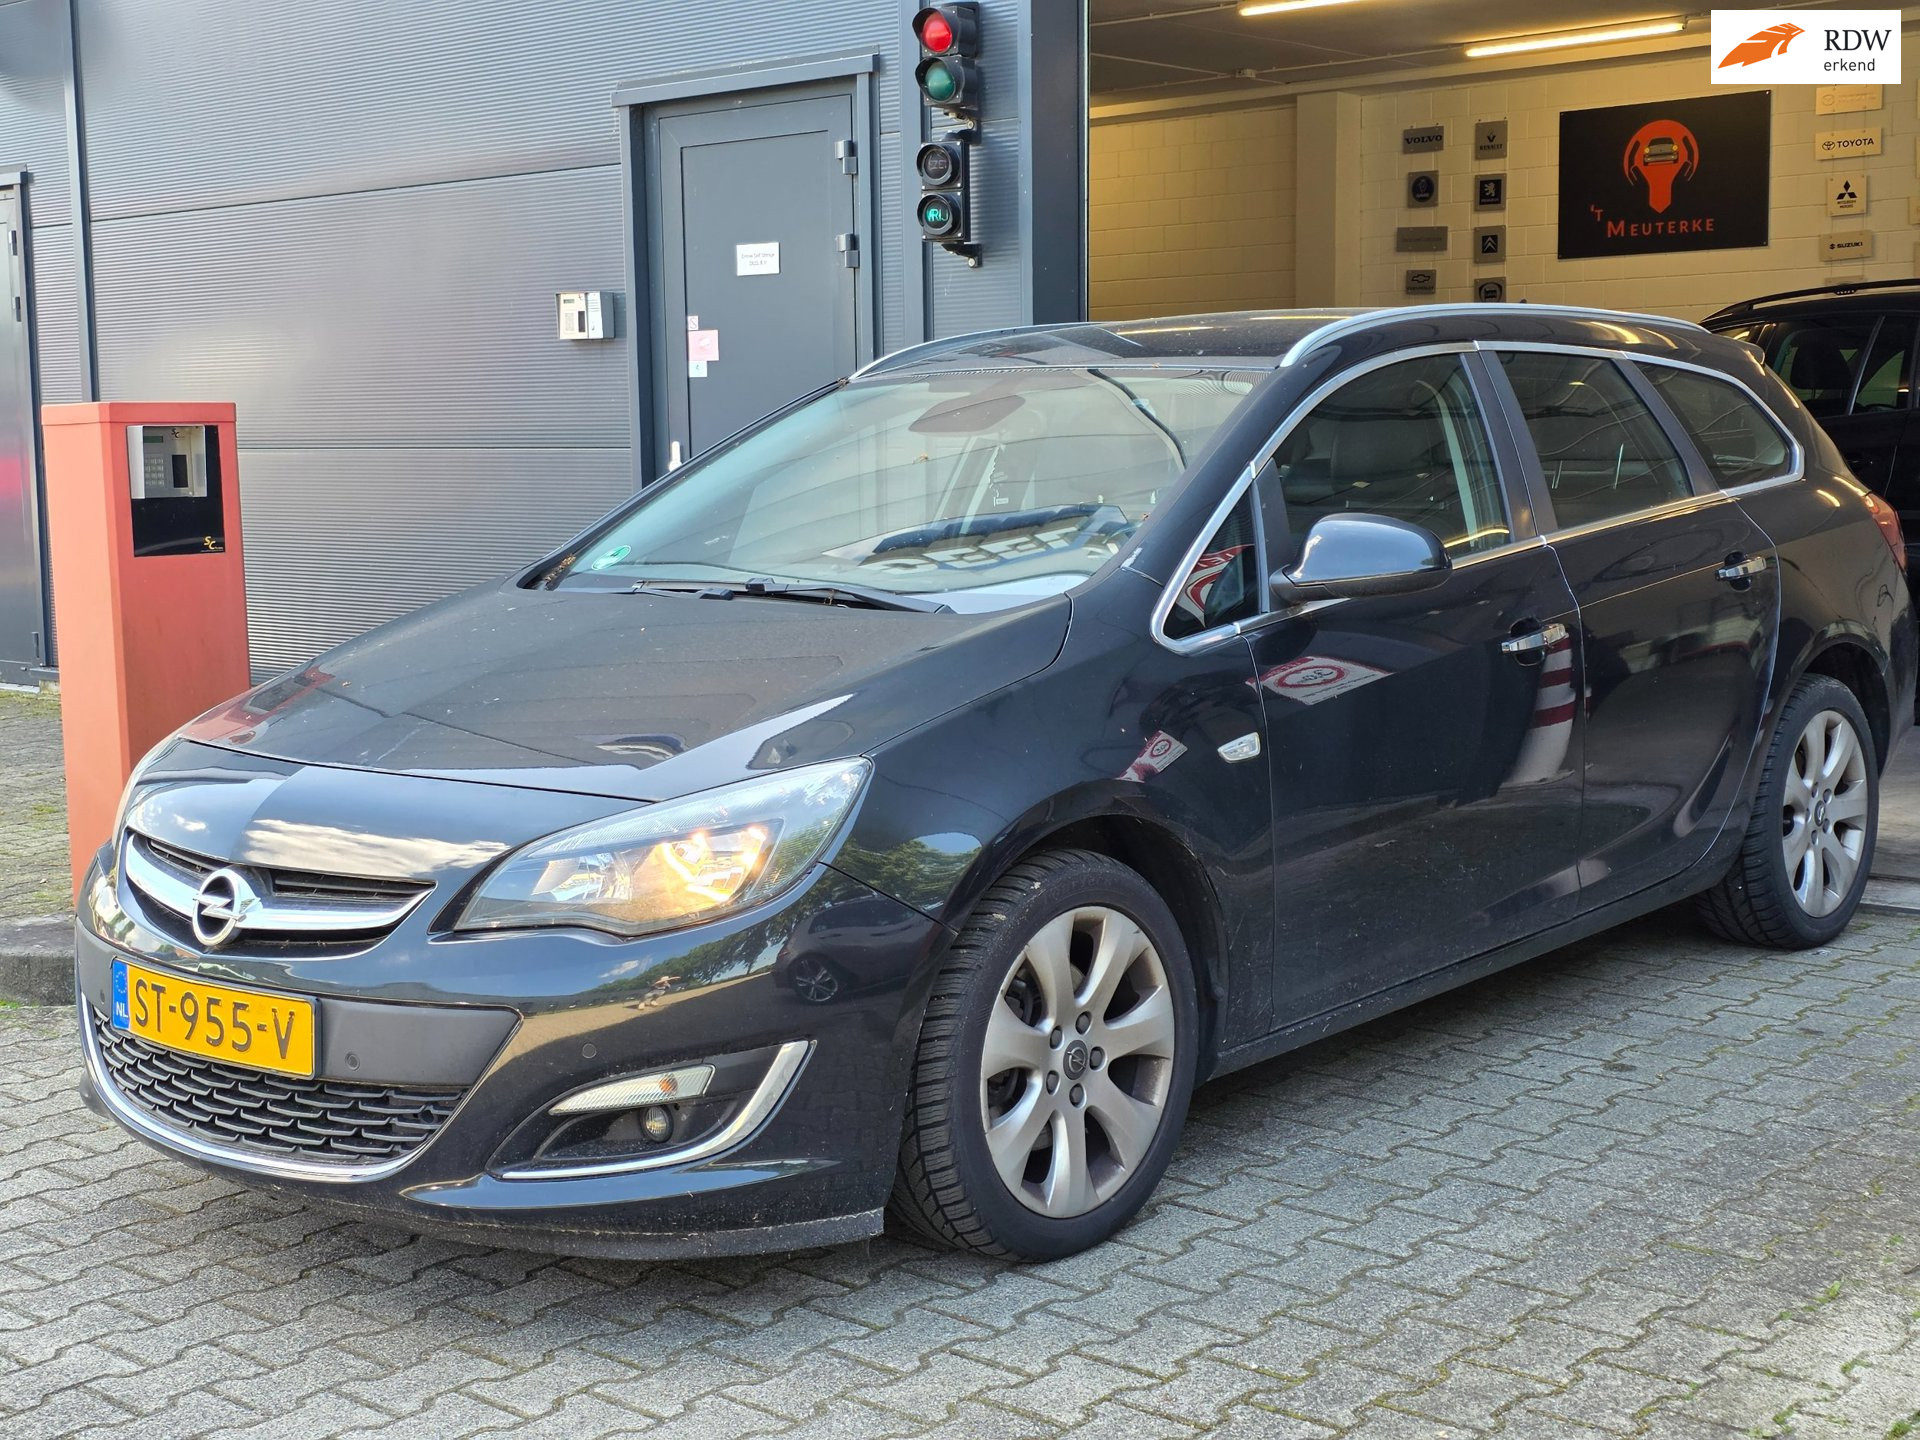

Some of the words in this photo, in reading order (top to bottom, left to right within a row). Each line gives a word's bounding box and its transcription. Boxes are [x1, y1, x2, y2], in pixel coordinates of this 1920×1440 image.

[1405, 134, 1443, 145] VOLVO
[1837, 138, 1874, 148] TOYOTA
[1837, 241, 1863, 249] SUZUKI
[115, 1002, 129, 1018] NL
[135, 977, 295, 1059] ST-955-V
